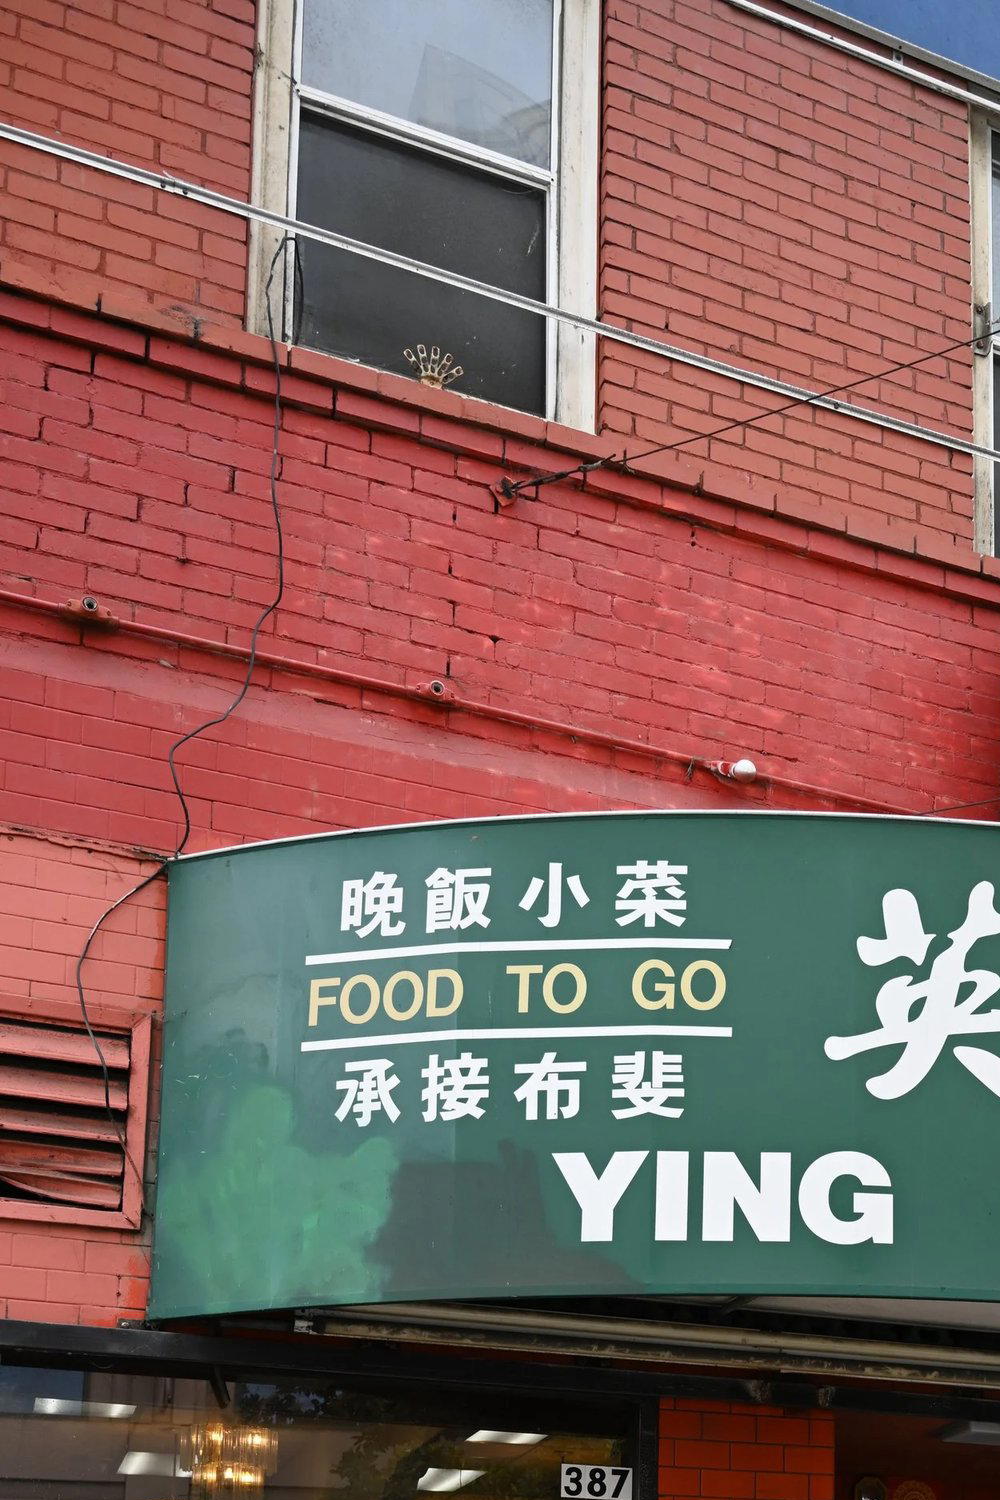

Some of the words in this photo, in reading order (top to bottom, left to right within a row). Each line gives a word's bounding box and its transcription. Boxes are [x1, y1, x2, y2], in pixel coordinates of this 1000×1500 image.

[340, 859, 689, 938] 晚飯小菜
[308, 968, 465, 1027] FOOD
[506, 963, 588, 1014] TO
[631, 959, 727, 1012] GO
[335, 1051, 687, 1128] 承接布斐
[551, 1150, 895, 1246] YING
[563, 1466, 632, 1500] 387
